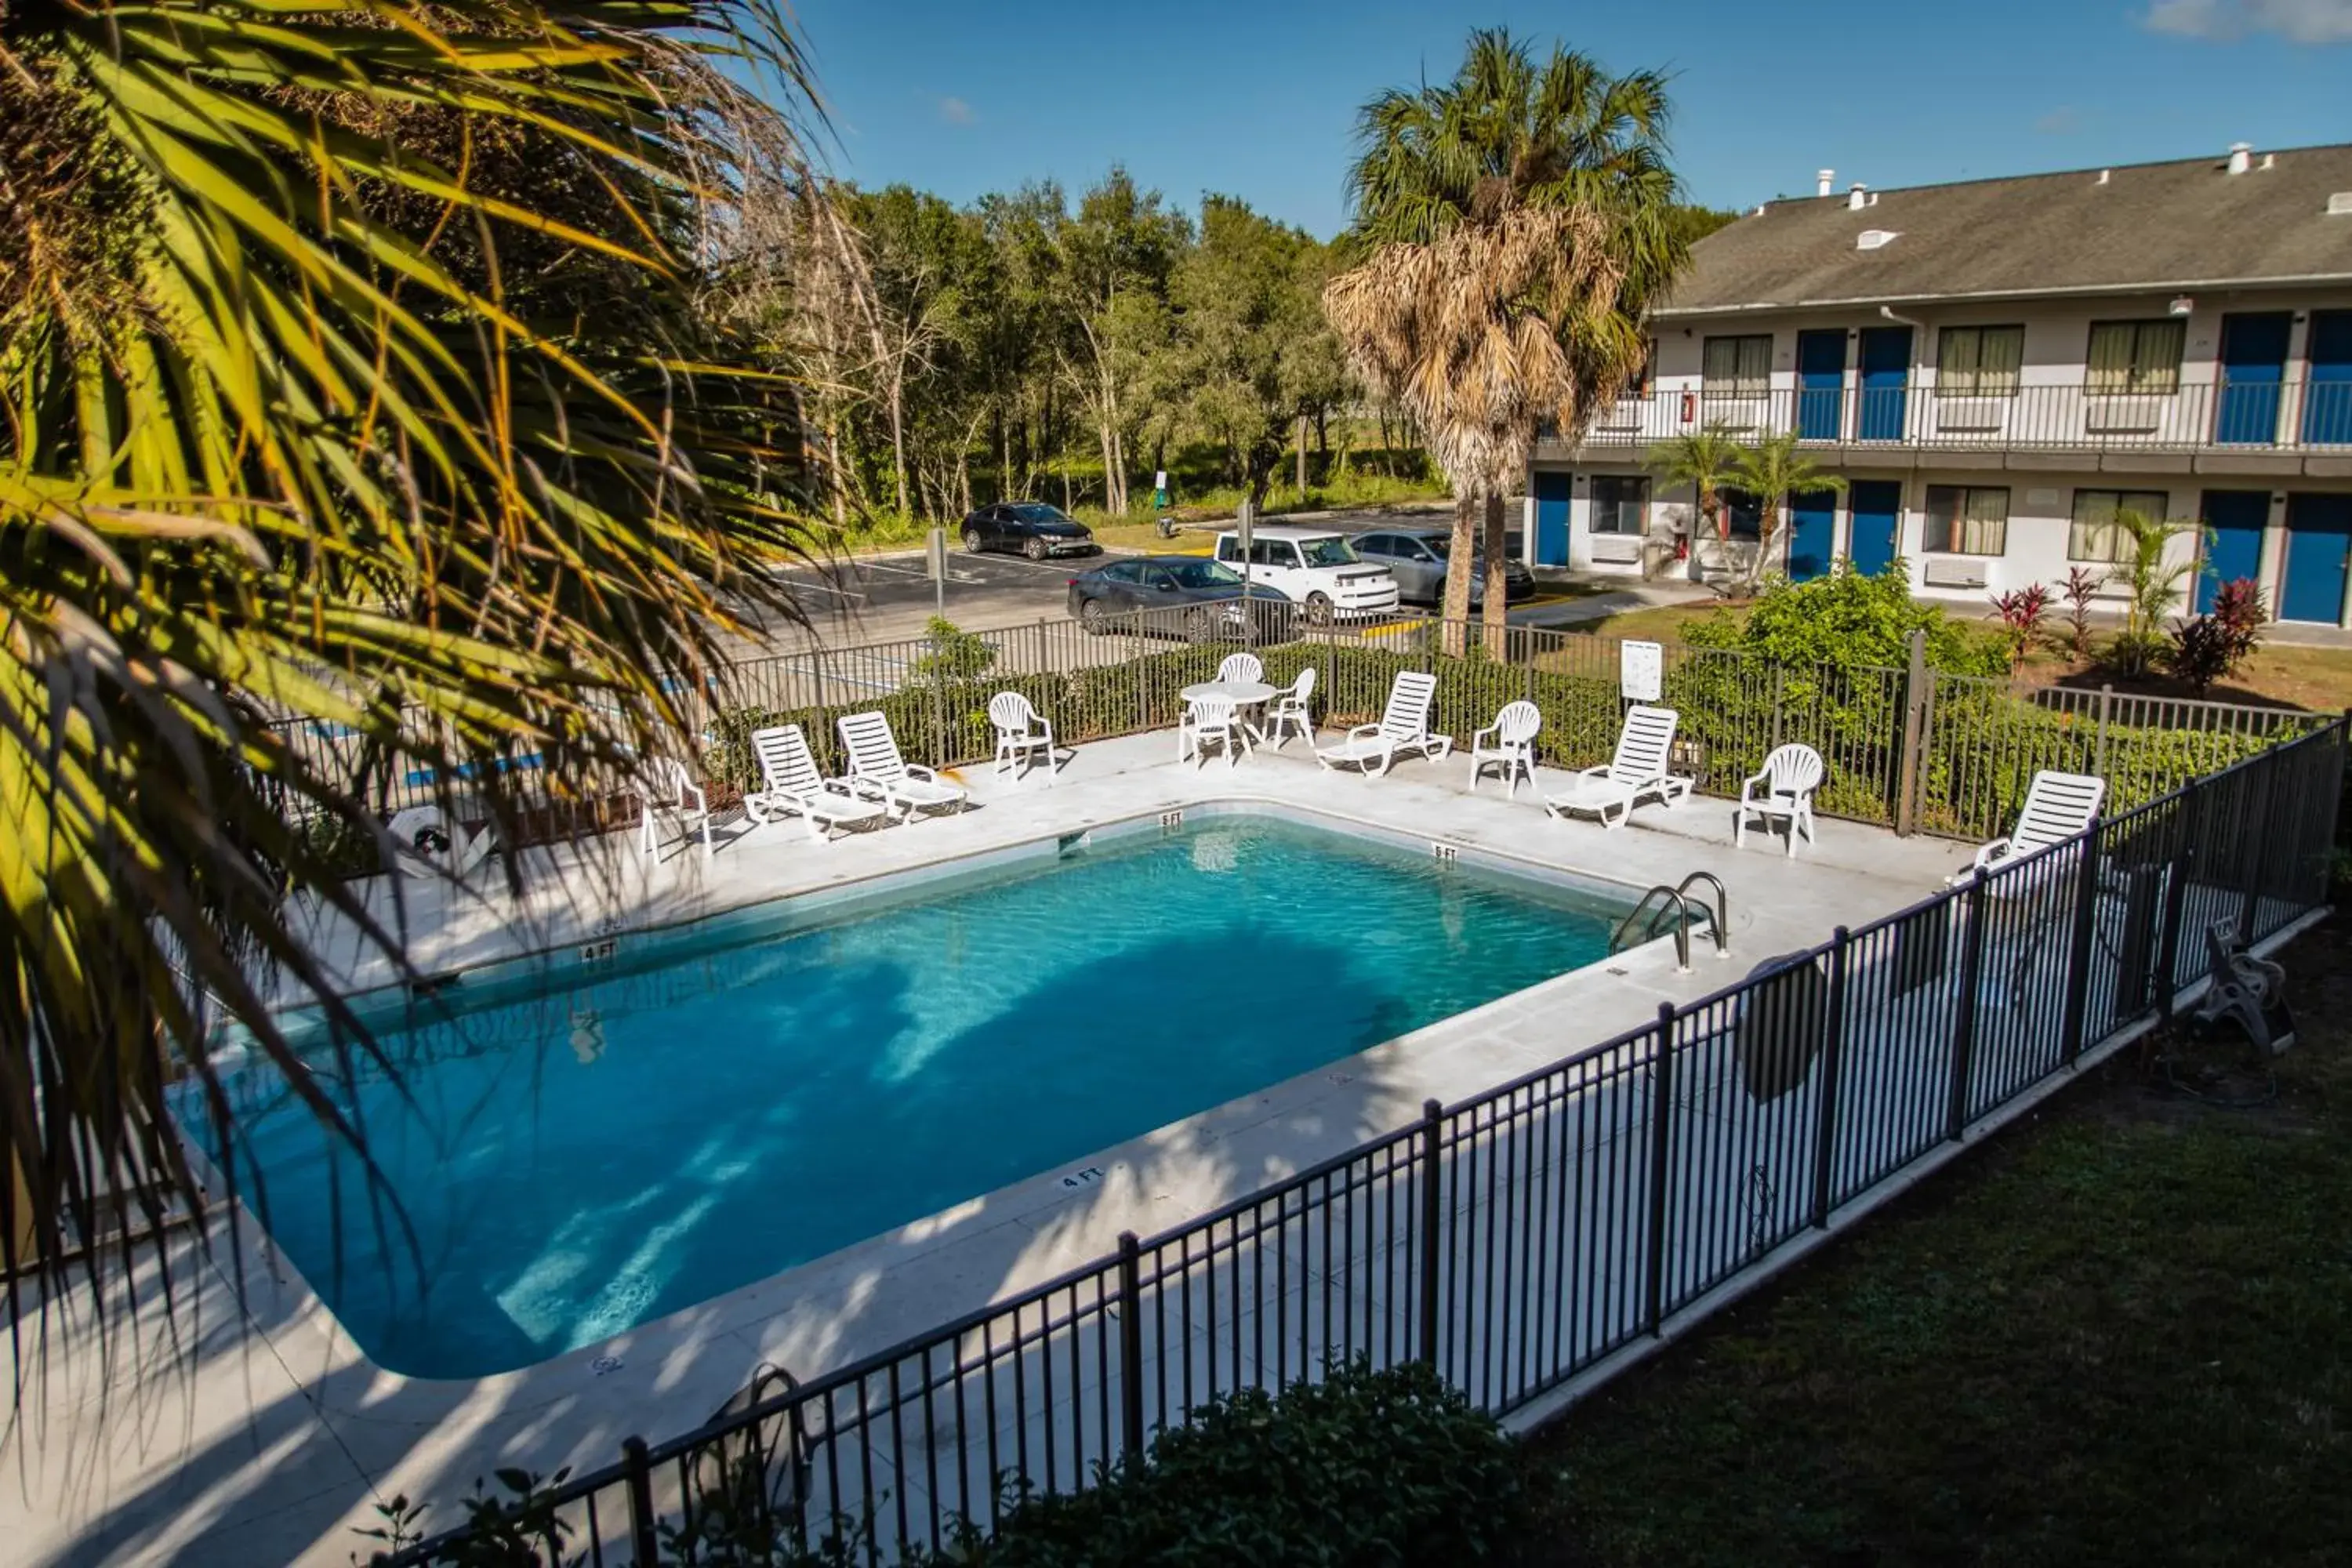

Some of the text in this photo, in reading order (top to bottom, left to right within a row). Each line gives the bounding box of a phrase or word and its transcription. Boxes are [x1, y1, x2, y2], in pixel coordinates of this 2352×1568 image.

[1171, 811, 1181, 826] FT
[1445, 848, 1456, 860] FT
[586, 943, 614, 958] 4 FT
[1063, 1167, 1105, 1187] 4 FT
